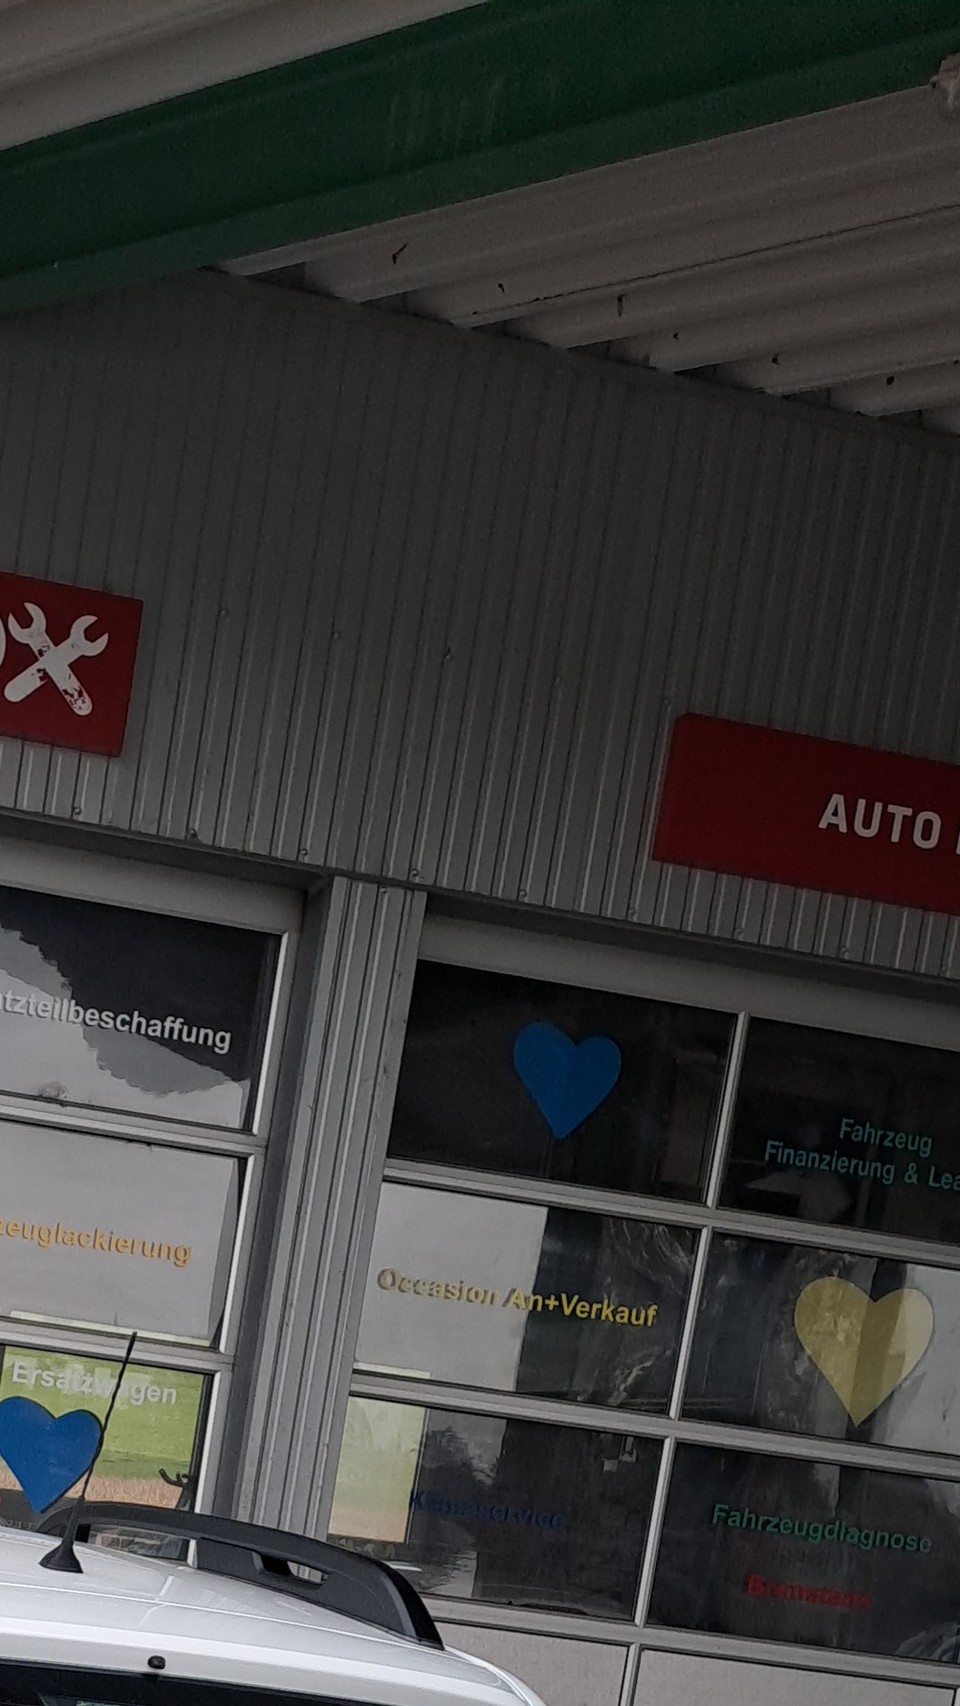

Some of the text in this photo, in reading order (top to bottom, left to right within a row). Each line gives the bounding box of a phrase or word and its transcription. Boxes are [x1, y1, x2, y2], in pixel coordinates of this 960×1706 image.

[818, 793, 941, 849] AUTO
[840, 1118, 933, 1158] Fahrzeug
[764, 1140, 896, 1185] Finanzierung
[903, 1162, 918, 1185] &
[377, 1267, 498, 1306] Occasion
[11, 1360, 177, 1405] Ersatzwgen
[712, 1502, 934, 1554] Fahrzeugdiagnose
